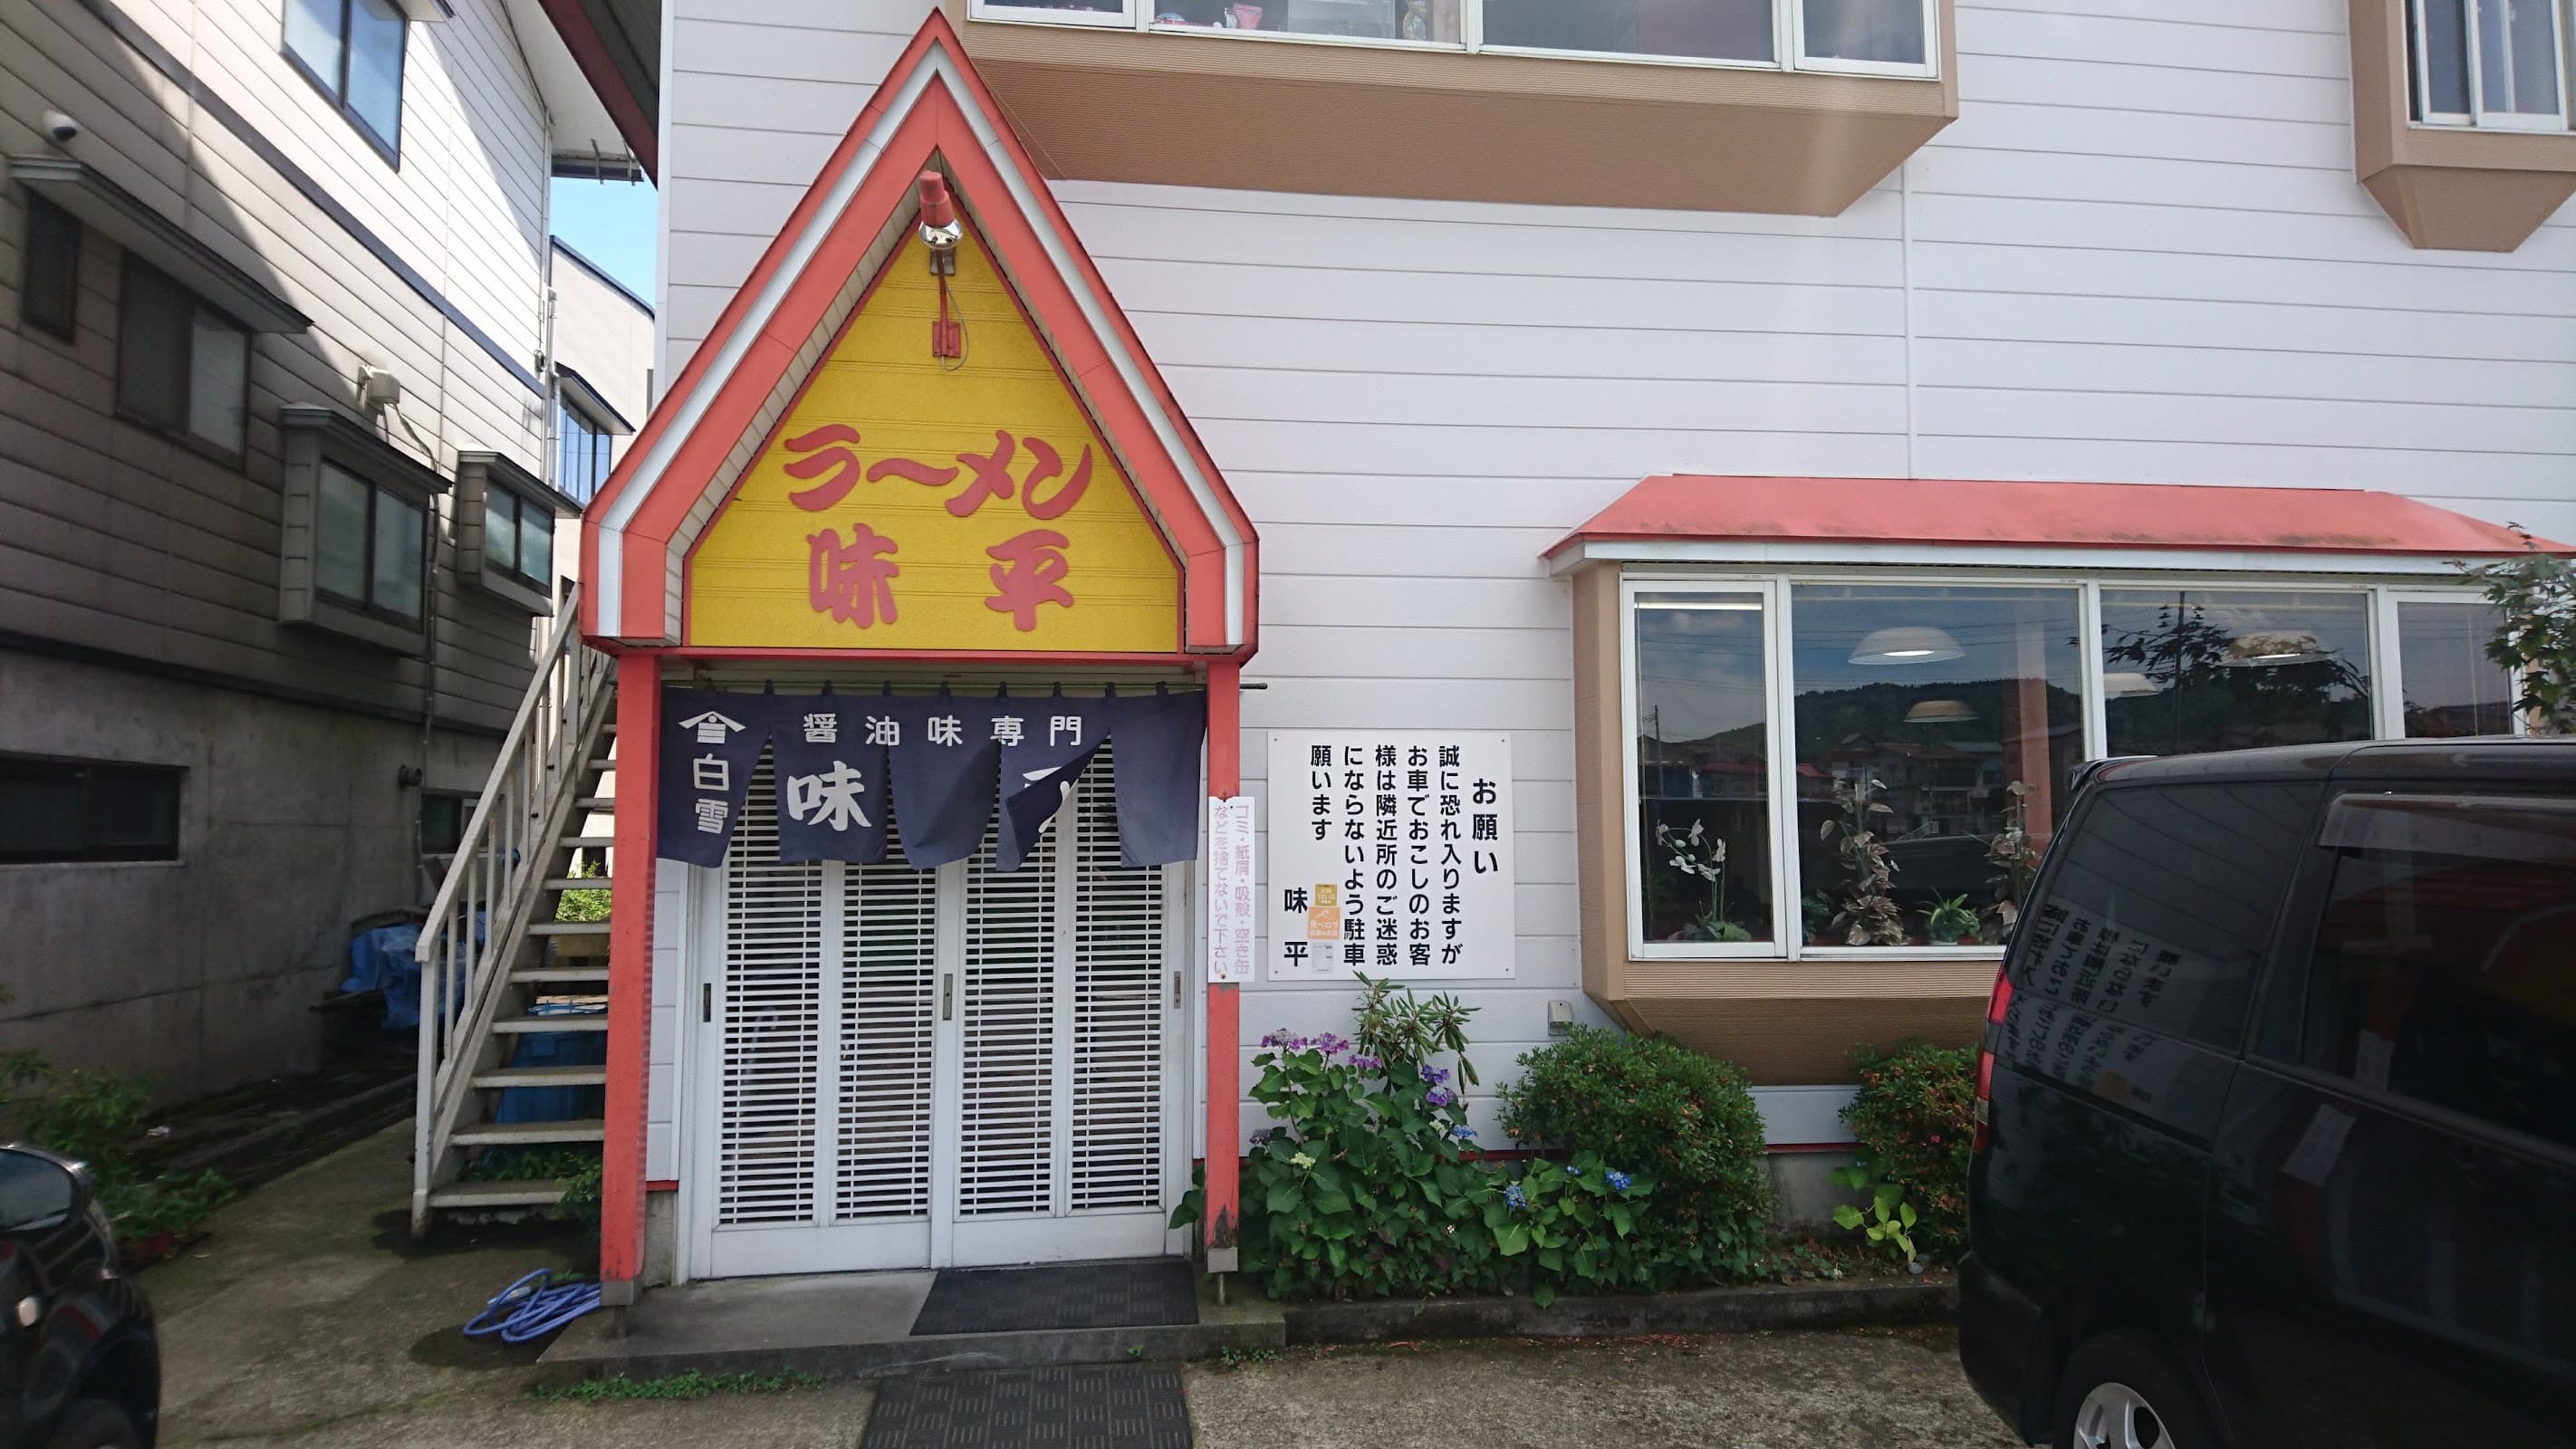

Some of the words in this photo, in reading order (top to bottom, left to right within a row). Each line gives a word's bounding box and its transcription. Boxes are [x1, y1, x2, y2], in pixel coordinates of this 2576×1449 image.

[783, 424, 1093, 520] ラーメン
[806, 522, 1074, 632] 味平
[803, 713, 1081, 747] 醤油味専門
[693, 753, 729, 834] 白雪
[787, 760, 872, 831] 味
[1310, 744, 1332, 841] 願います
[1472, 778, 1499, 874] お願い
[1343, 745, 1366, 966] にならないよう駐車
[1375, 744, 1398, 965] 様は隣近所のご迷惑
[1407, 745, 1431, 966] お車でおこしのお客
[1438, 744, 1464, 964] 誠に恐れ入りますが
[1283, 887, 1309, 967] 味平
